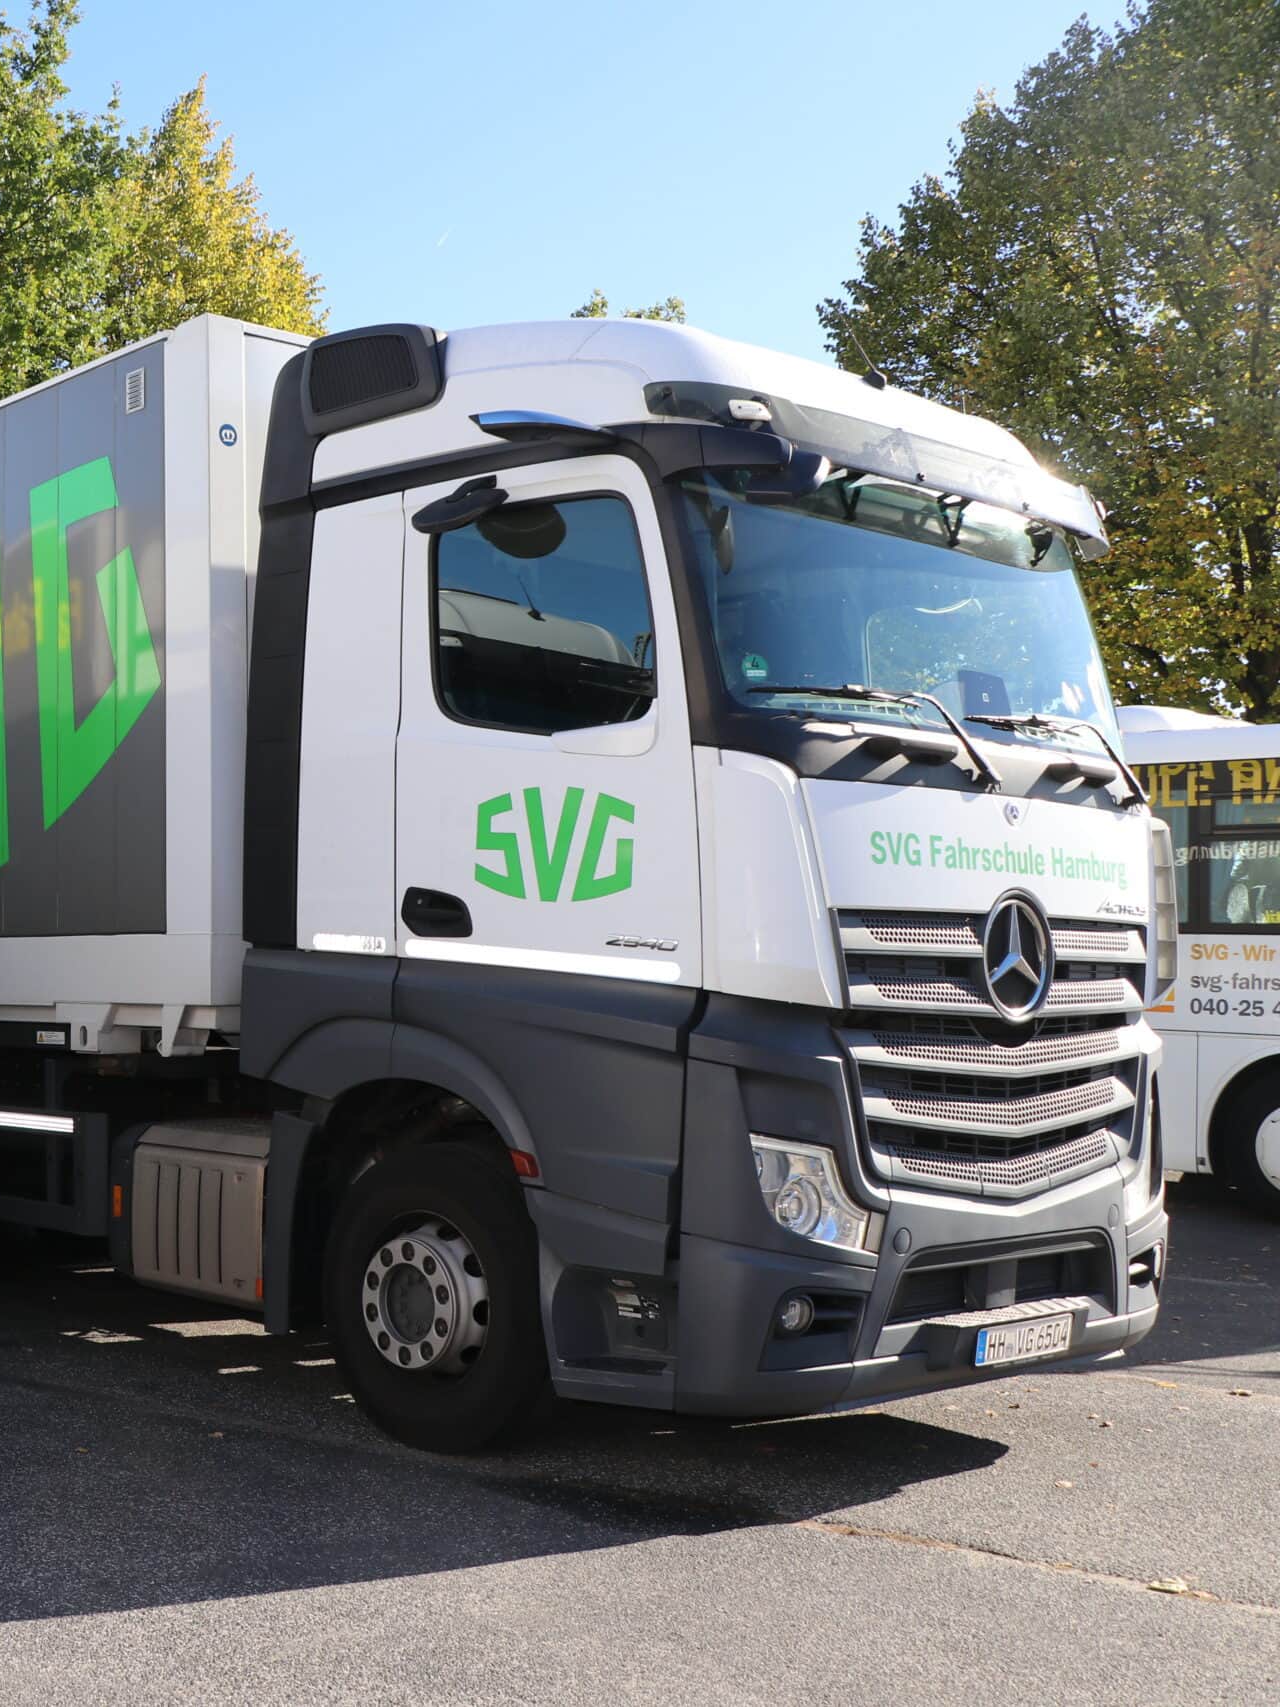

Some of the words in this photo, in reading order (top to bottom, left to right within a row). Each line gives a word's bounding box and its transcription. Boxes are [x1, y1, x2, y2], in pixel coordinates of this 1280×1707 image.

[474, 785, 636, 903] SVG
[870, 830, 922, 867] SVG
[929, 834, 1046, 876] Fahrschule
[1051, 847, 1129, 891] Hamburg
[606, 935, 679, 952] 2540
[1190, 943, 1229, 961] SVG
[1242, 943, 1277, 962] Wir
[986, 1330, 1007, 1360] HH
[1015, 1327, 1035, 1354] VG
[1037, 1318, 1068, 1350] 6504
